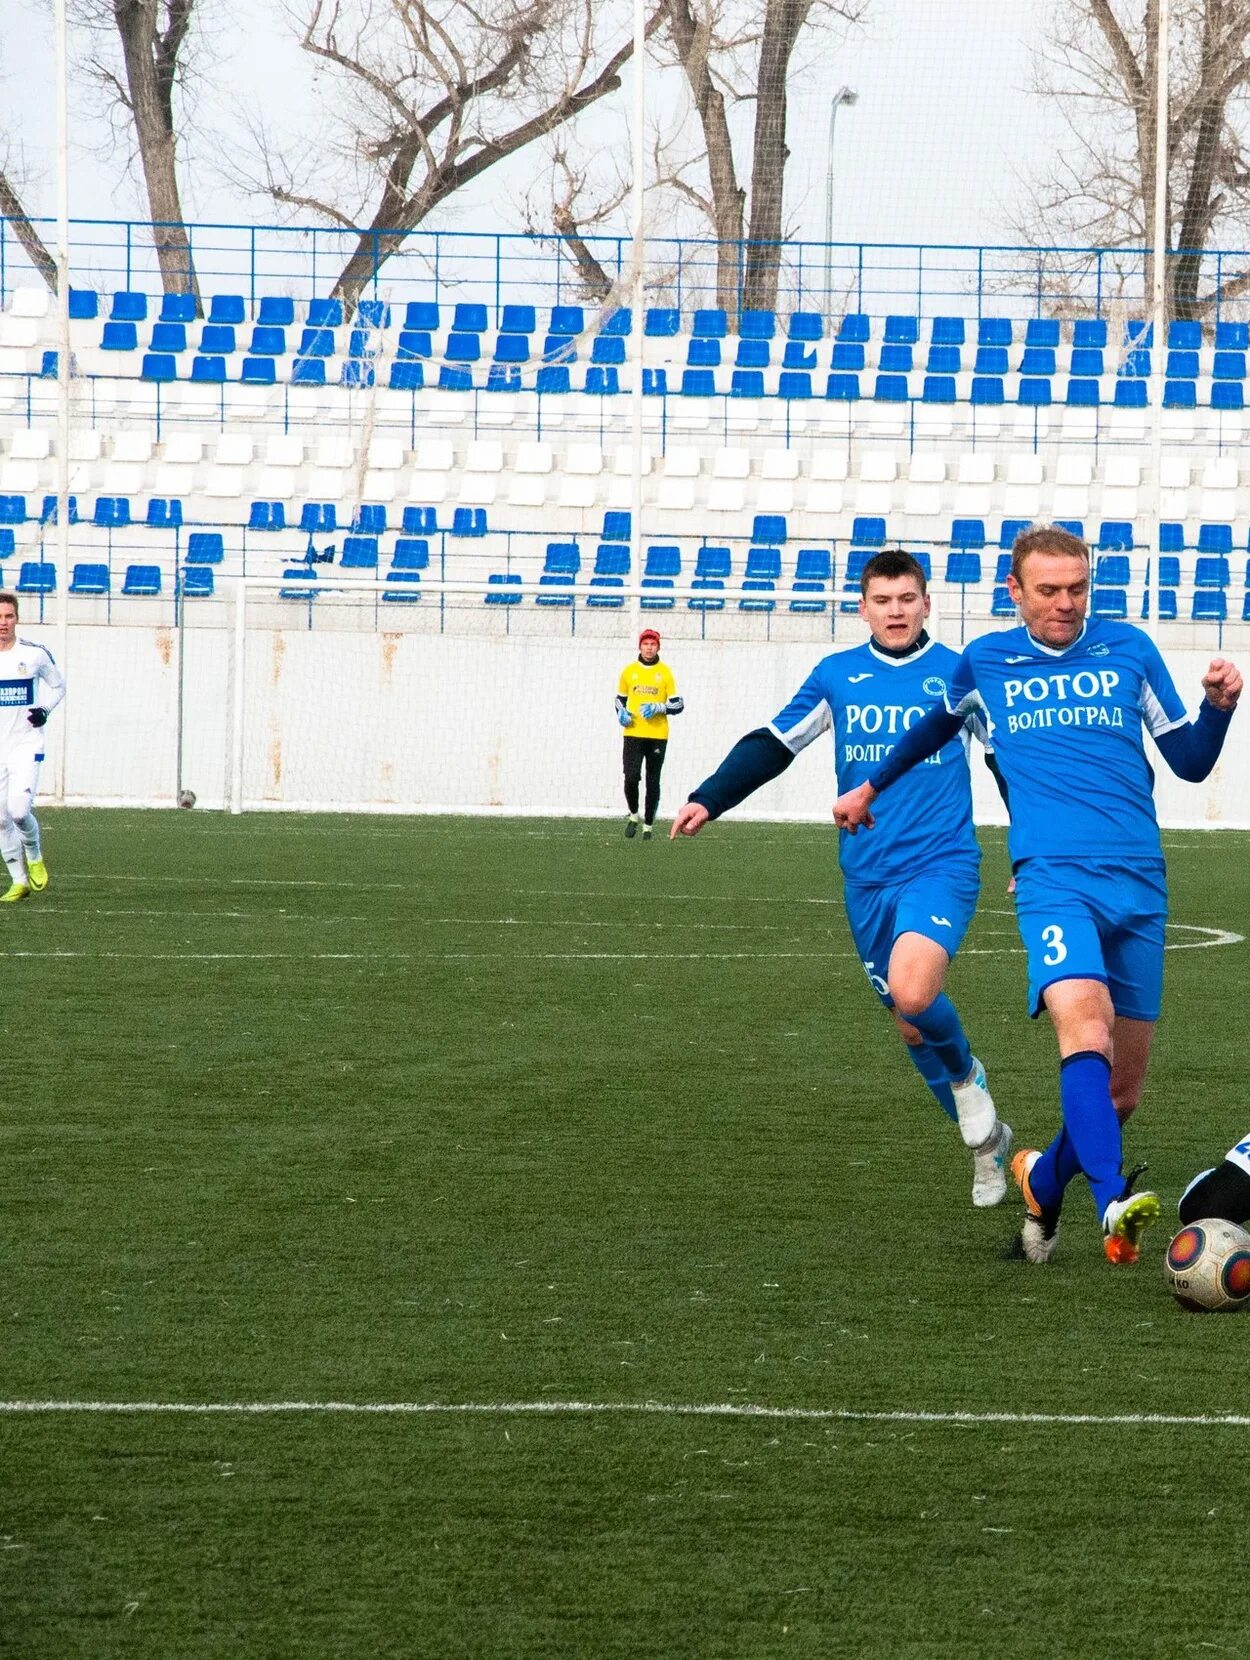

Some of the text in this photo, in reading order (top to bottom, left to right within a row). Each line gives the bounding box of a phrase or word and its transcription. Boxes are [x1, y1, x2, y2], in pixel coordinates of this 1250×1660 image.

[1003, 670, 1120, 707] РОТОР
[845, 704, 932, 734] РОТО
[1007, 706, 1124, 734] ВОЛГОГРАД
[1041, 924, 1068, 966] 3
